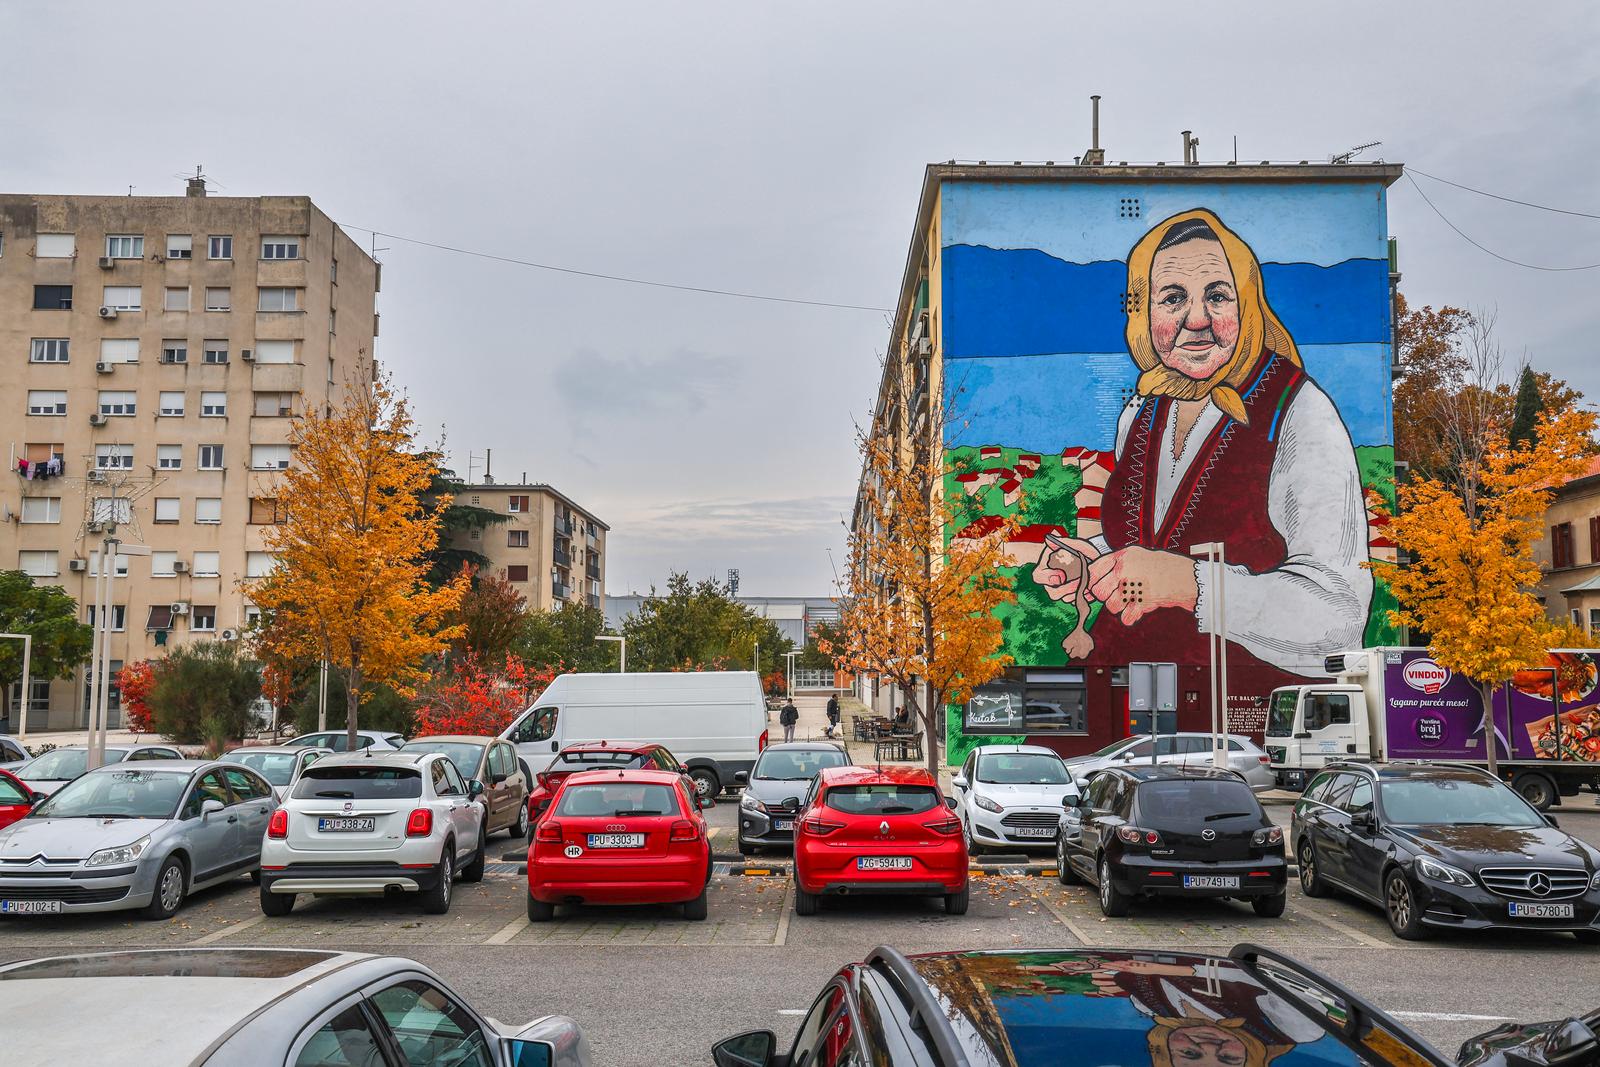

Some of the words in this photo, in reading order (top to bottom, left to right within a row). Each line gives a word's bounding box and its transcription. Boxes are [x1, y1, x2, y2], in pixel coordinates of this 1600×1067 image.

[1408, 670, 1445, 679] VINDON
[1389, 697, 1419, 708] Lagano
[1446, 698, 1469, 707] meso!
[968, 712, 998, 723] Kutak
[1420, 724, 1435, 735] broj
[324, 819, 336, 829] PU
[341, 819, 373, 829] 338-ZA
[1019, 828, 1028, 836] PU
[594, 834, 605, 845] PU
[610, 834, 640, 845] 3303-I
[567, 847, 580, 856] HR
[863, 858, 875, 868] ZG
[879, 858, 912, 868] 5941-JD
[1190, 877, 1200, 887] PU
[1206, 877, 1237, 887] 7491-J
[8, 901, 19, 911] PU
[25, 901, 56, 912] 2102-E
[1517, 904, 1529, 916] PU
